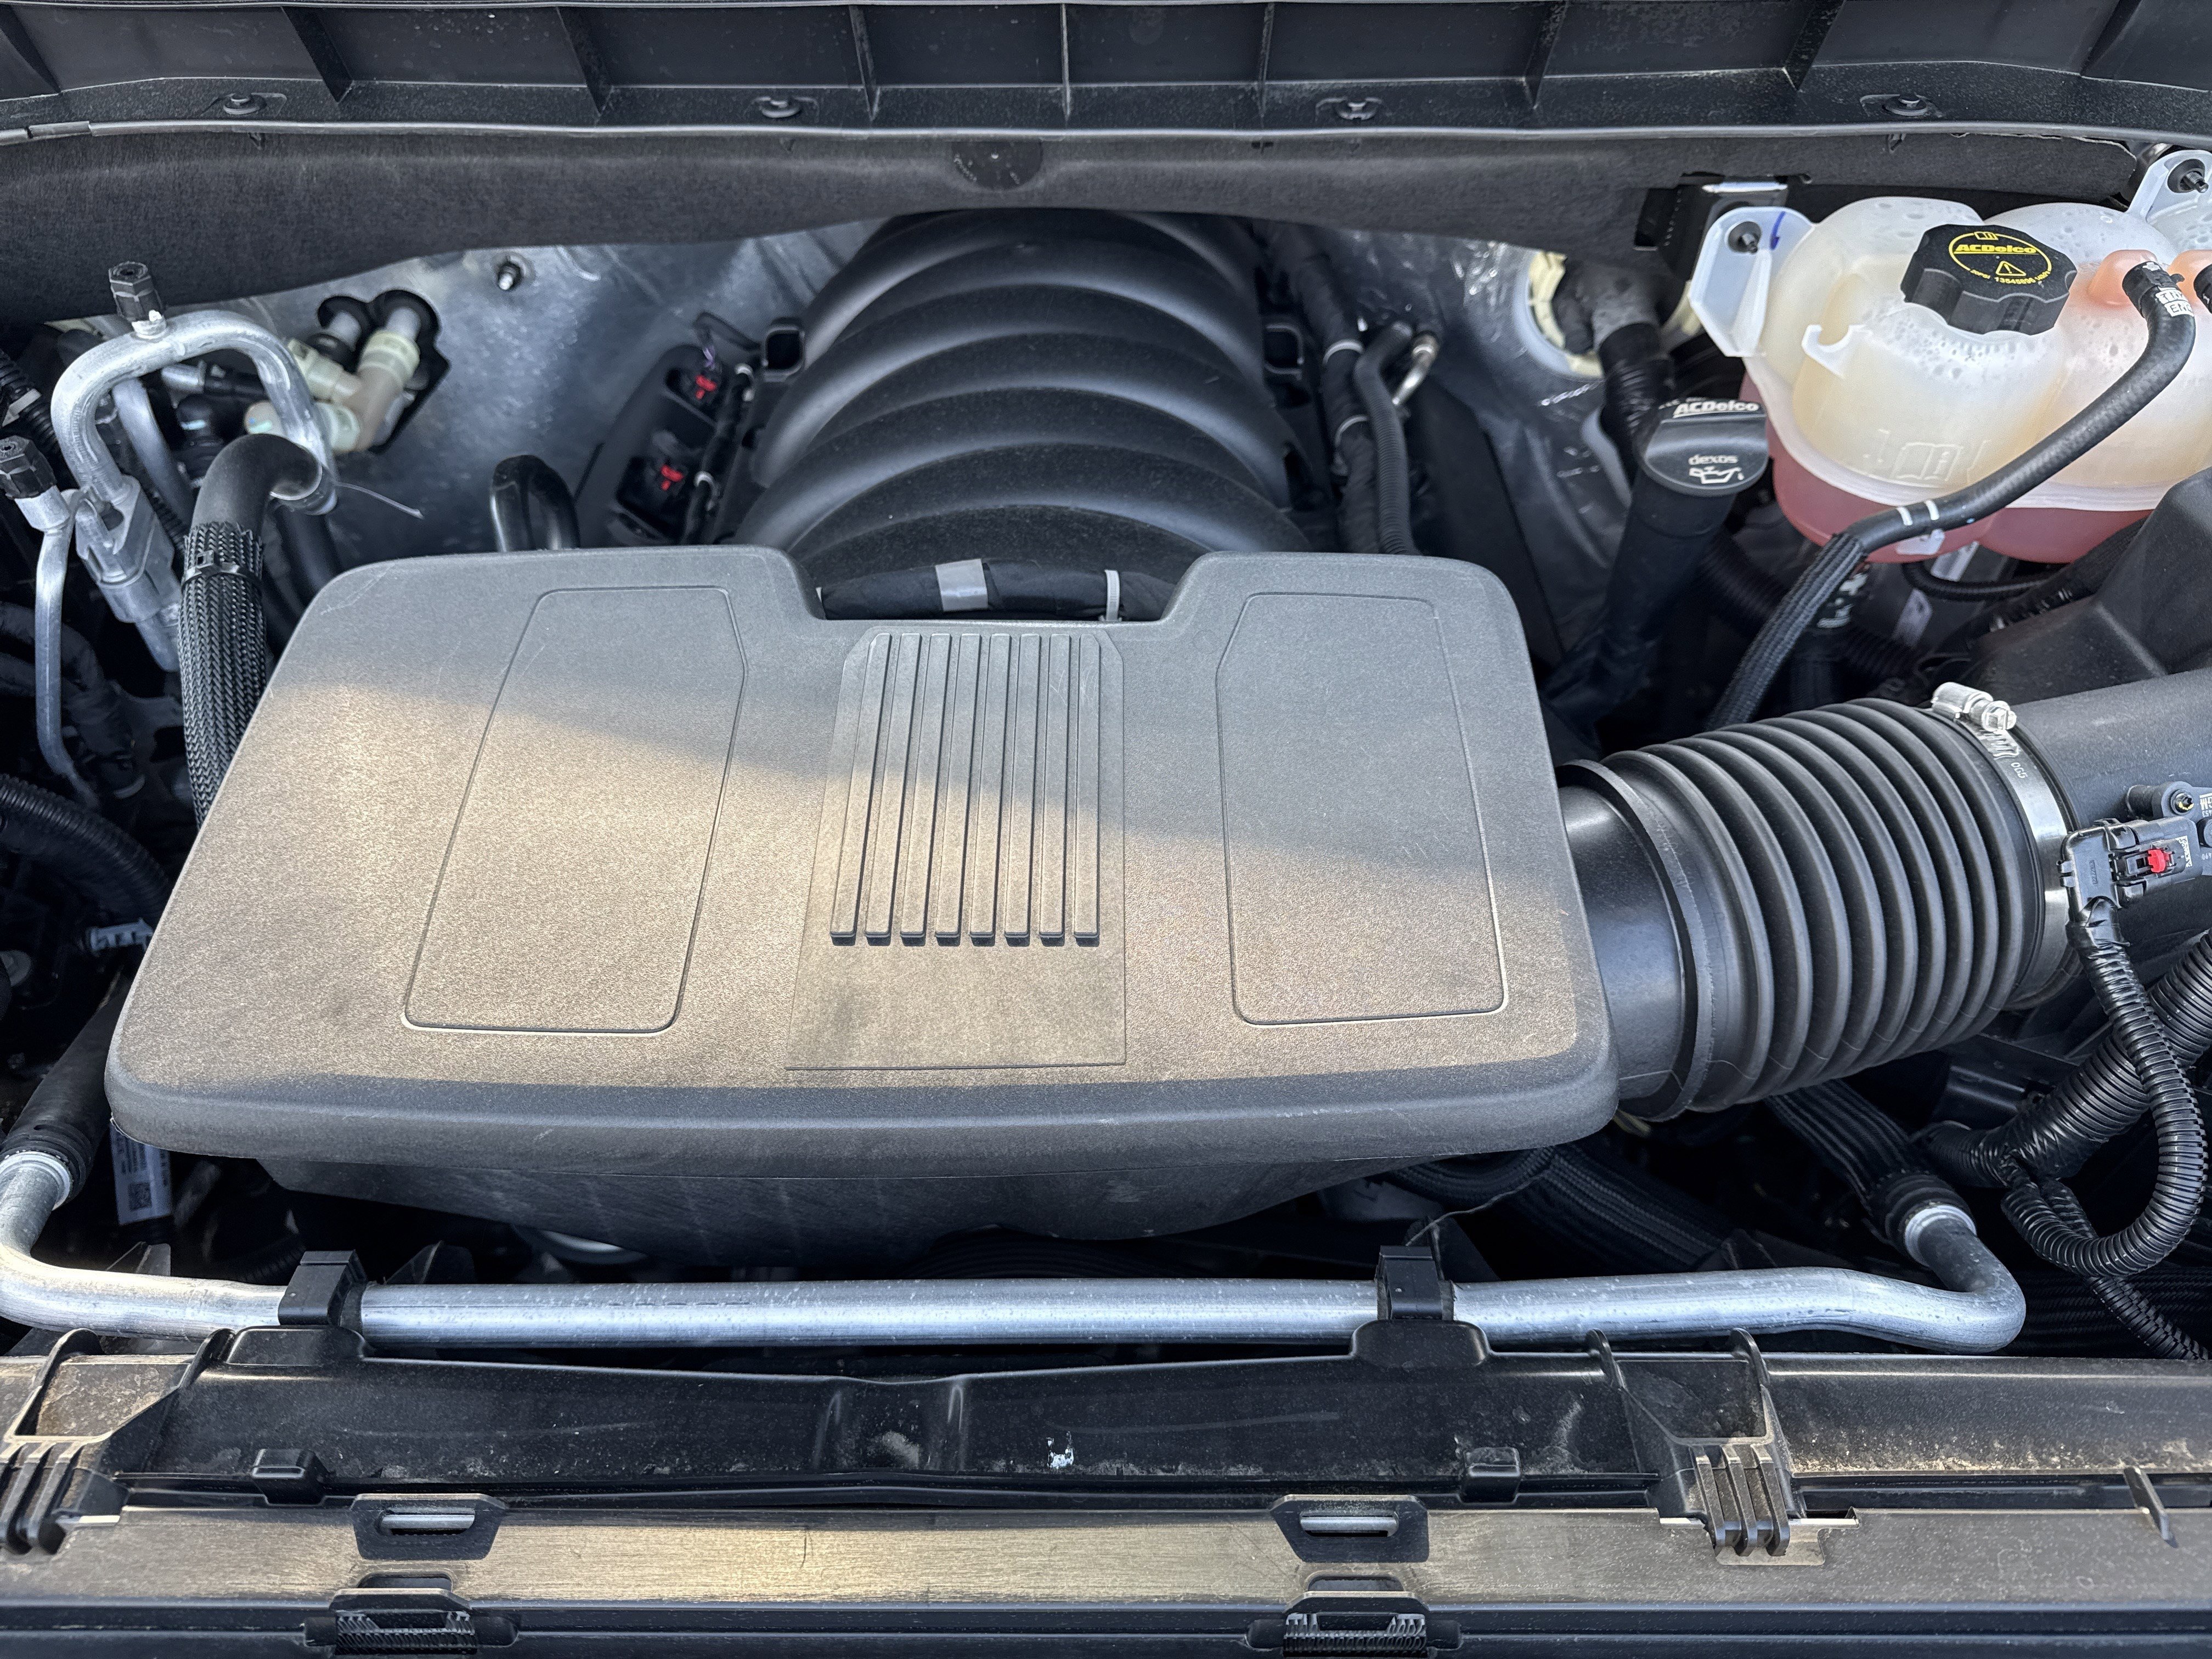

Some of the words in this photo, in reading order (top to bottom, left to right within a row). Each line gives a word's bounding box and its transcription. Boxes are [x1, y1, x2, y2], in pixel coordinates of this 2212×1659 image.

[1955, 244, 2036, 253] ACDelco
[1674, 399, 1759, 416] ACDelco
[1688, 454, 1738, 465] dexos
